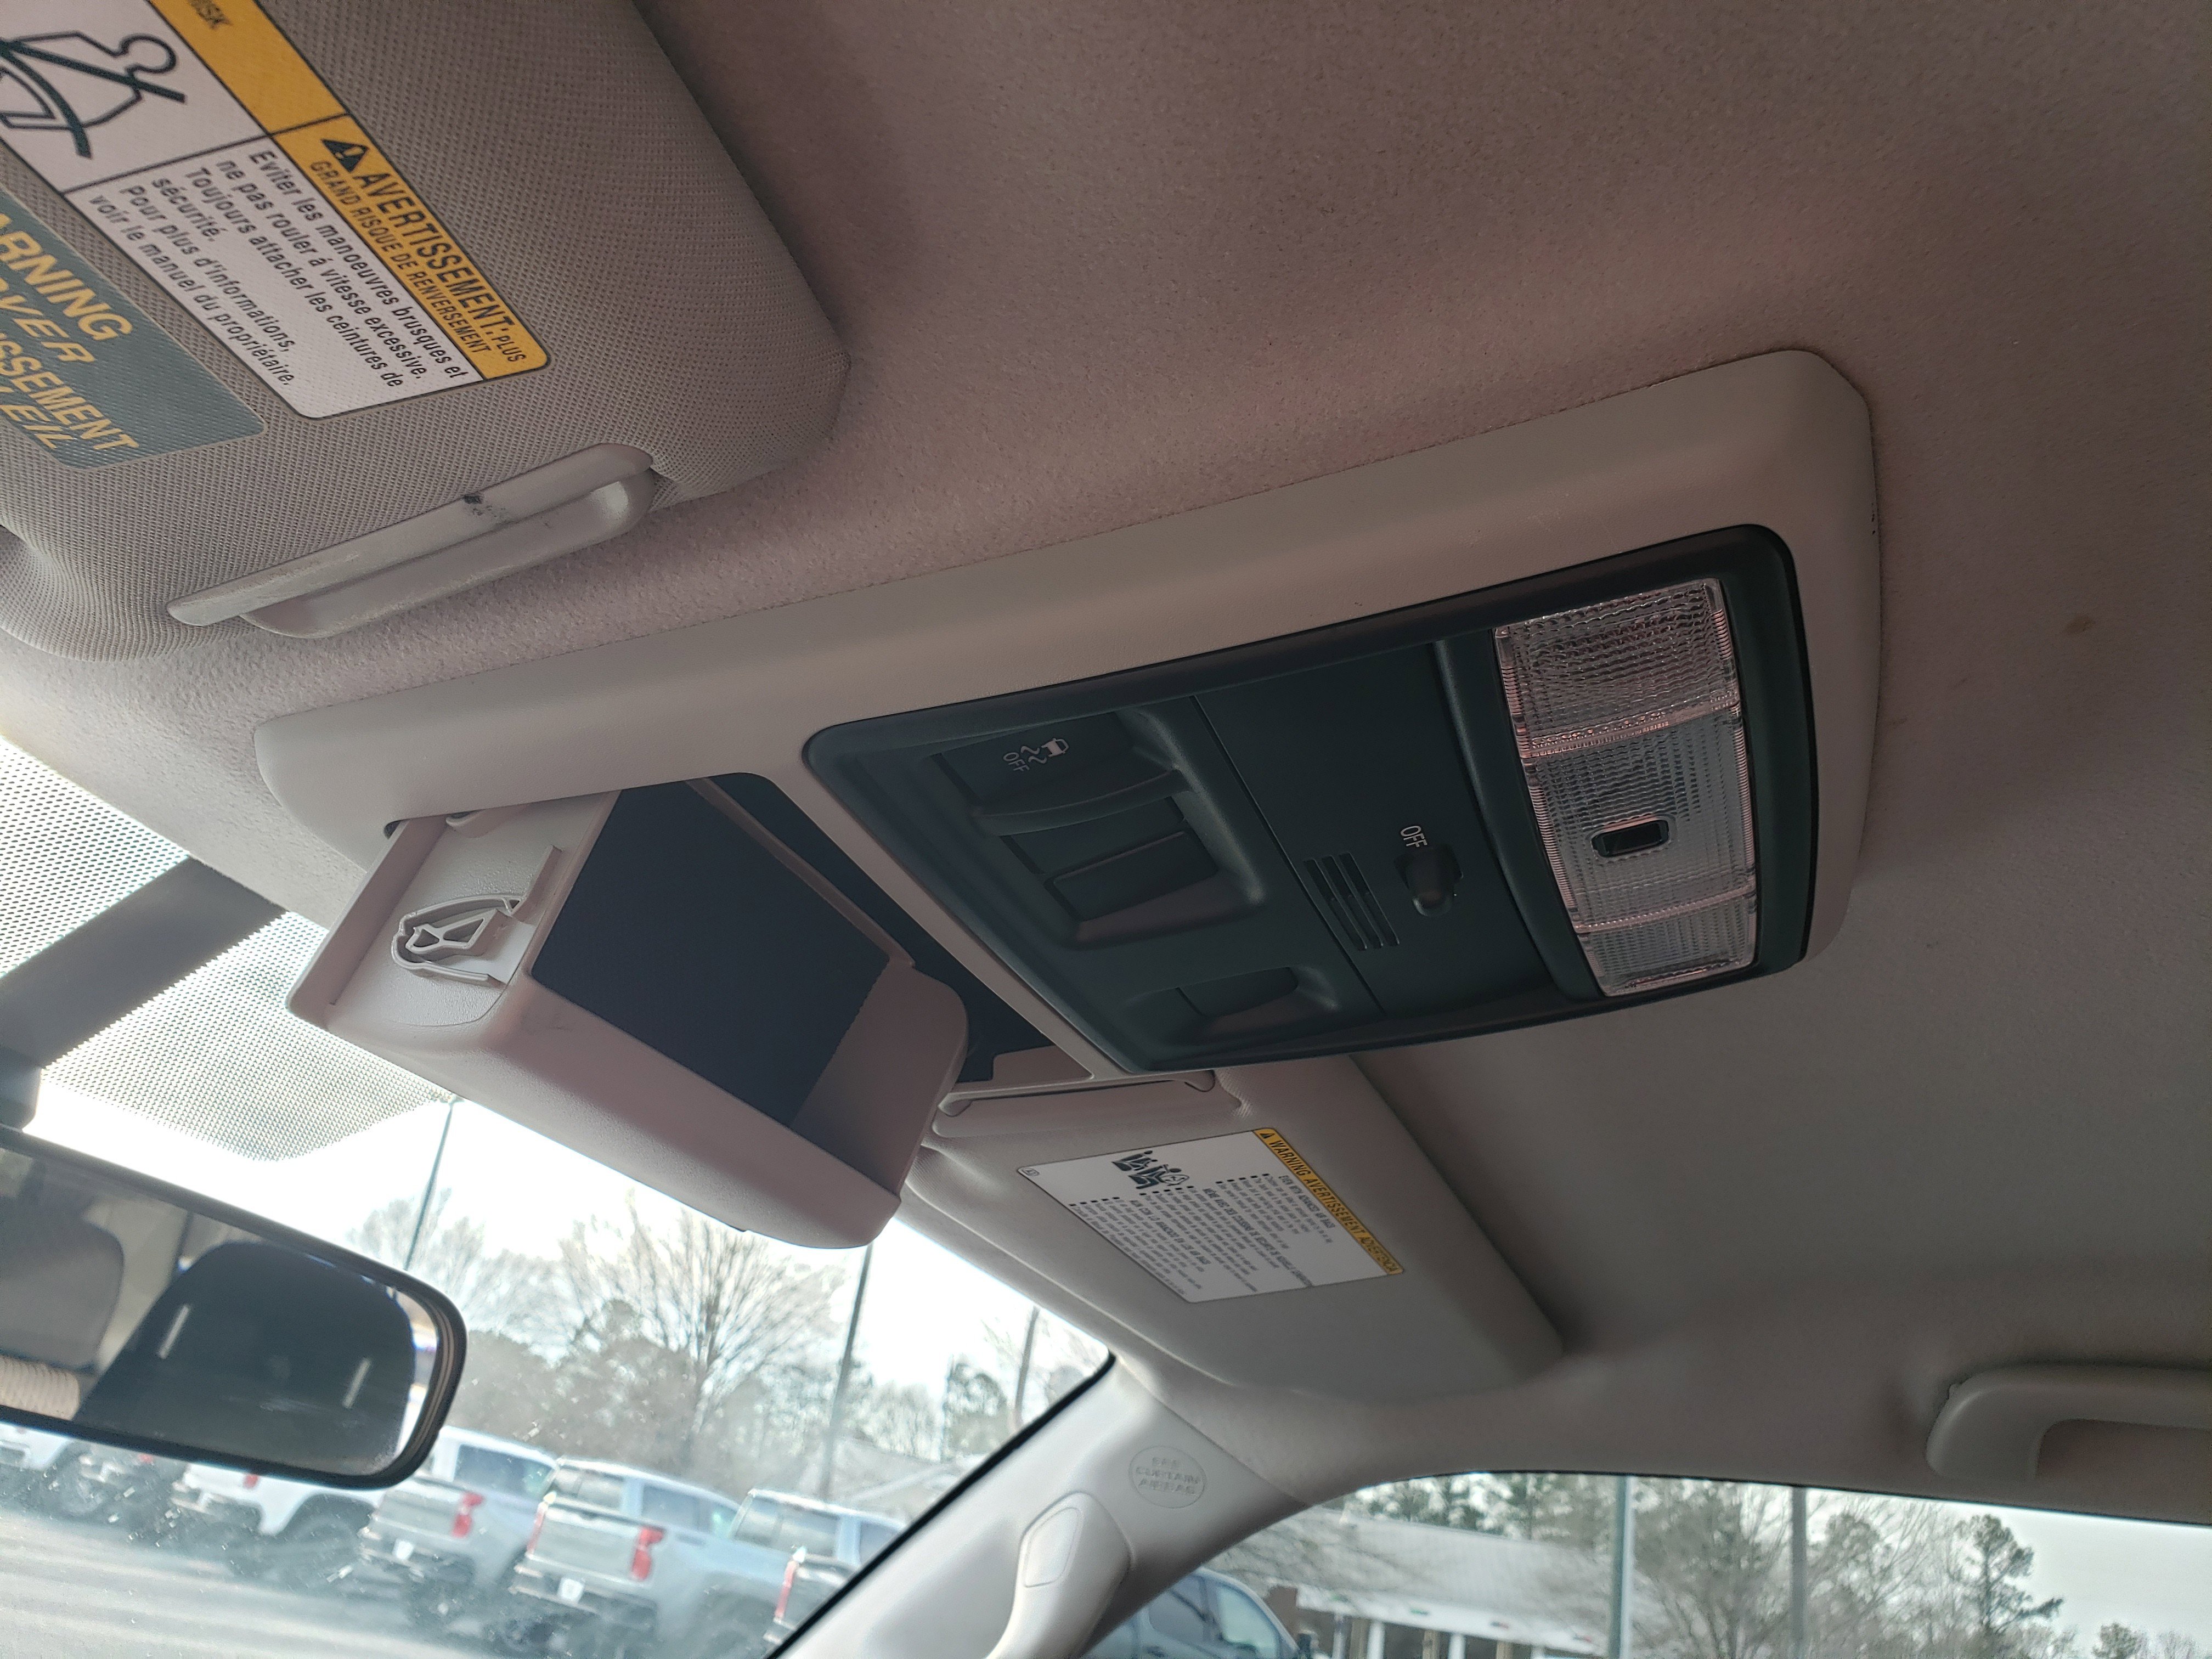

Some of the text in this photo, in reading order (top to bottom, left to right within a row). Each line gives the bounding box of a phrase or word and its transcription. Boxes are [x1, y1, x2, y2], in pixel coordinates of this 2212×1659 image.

[216, 160, 246, 180] ne
[230, 183, 274, 211] pas
[151, 178, 228, 242] sécurité.
[265, 212, 319, 254] rouler
[119, 185, 296, 352] Pour plus d'informations,
[185, 167, 404, 387] Toujours attacher les ceintures de
[248, 150, 469, 379] Eviter les manoeuvres brusques et
[309, 161, 492, 353] GRAND RISQUE DE RENVERSEMENT
[352, 172, 527, 362] AVERTISSEMENT: PLUS
[0, 277, 95, 362] VER
[89, 195, 295, 386] voir le manuel du propriétaire.
[320, 268, 373, 315] vitesse
[364, 317, 427, 379] excessive.
[0, 386, 74, 449] EIL
[1003, 752, 1030, 771] OFF
[1400, 825, 1427, 848] OFF
[1269, 1140, 1311, 1176] WARNING
[1303, 1179, 1365, 1234] AVERTISSEMENT
